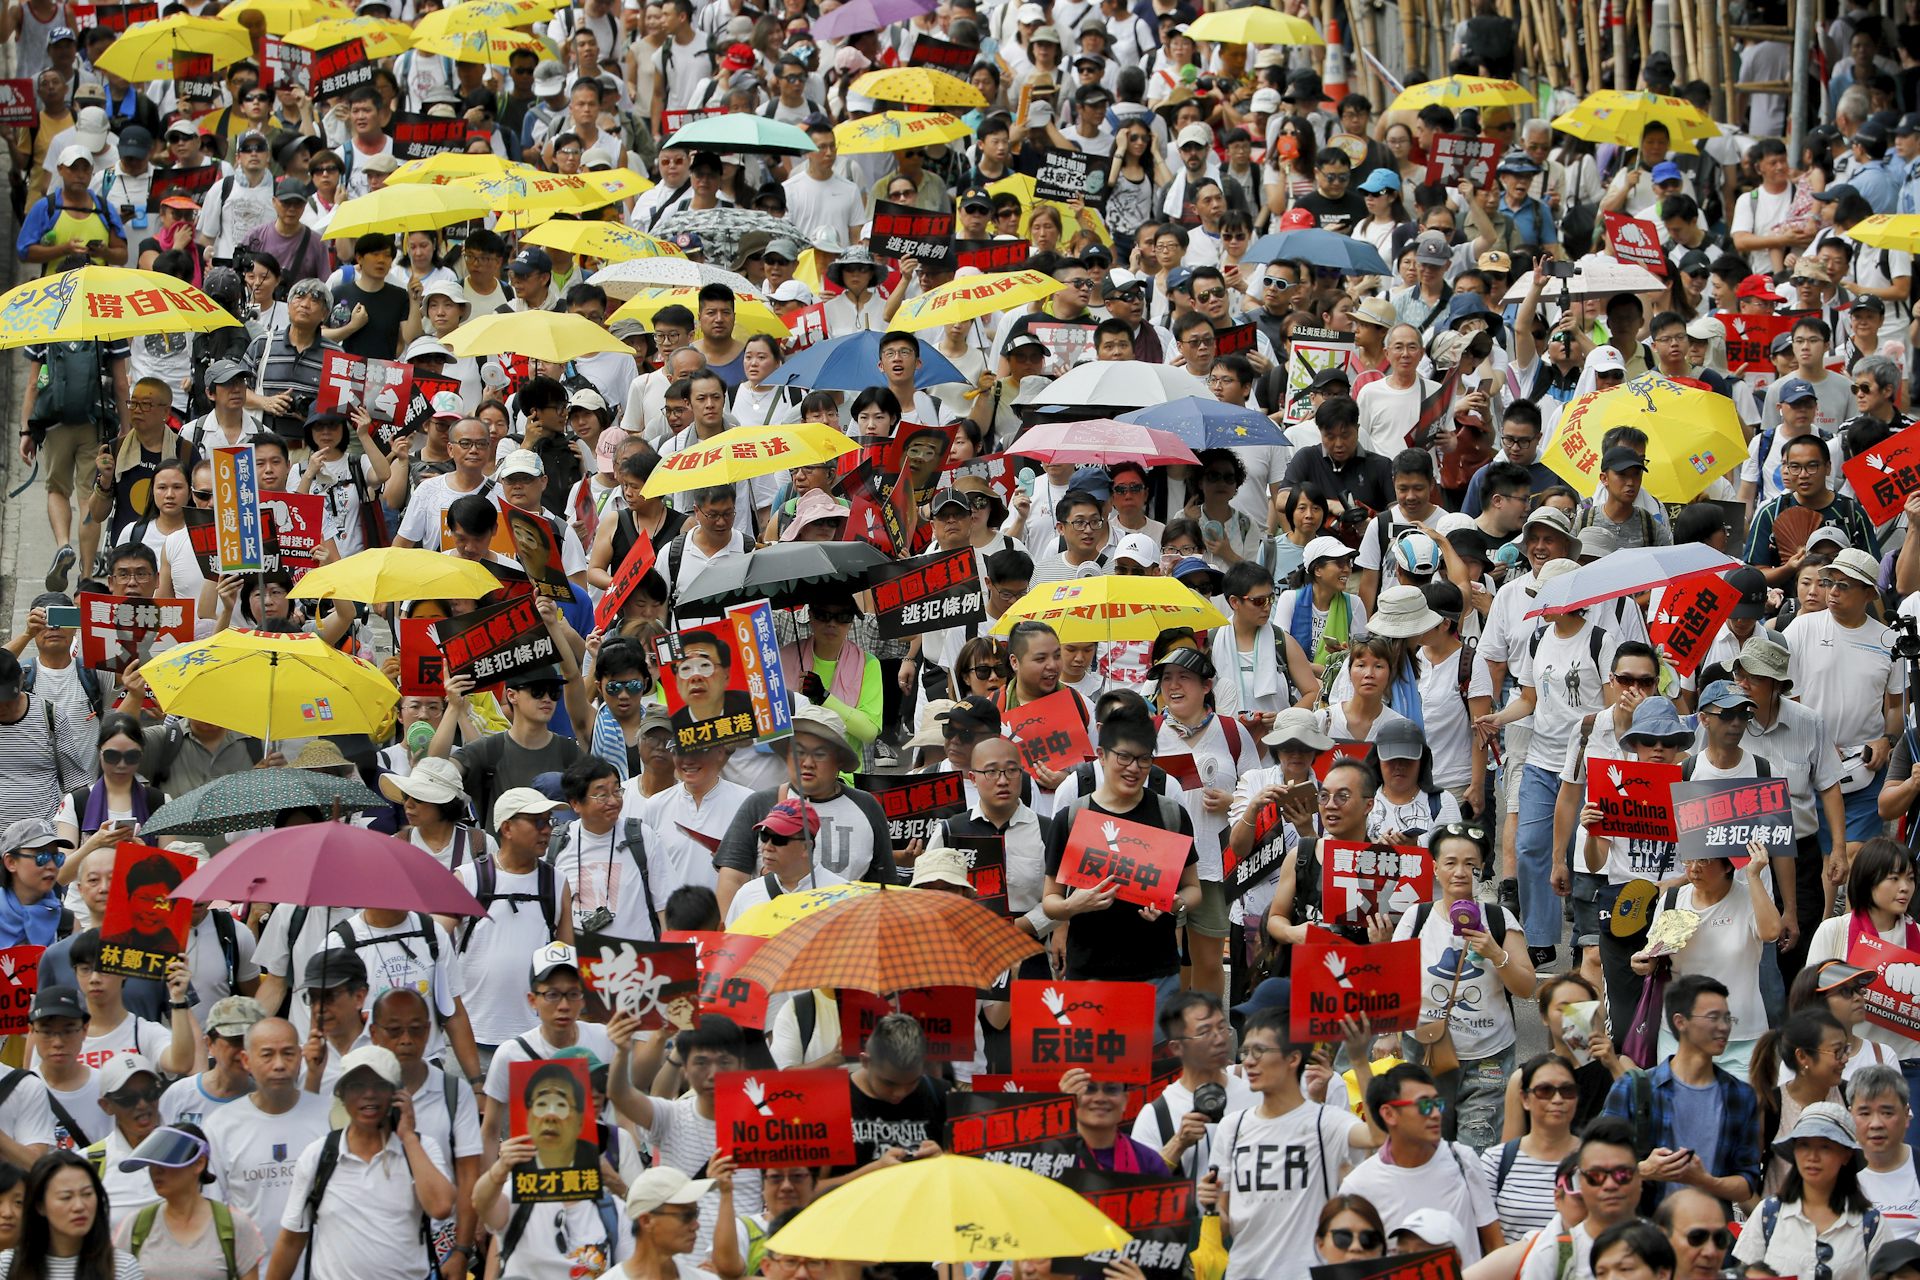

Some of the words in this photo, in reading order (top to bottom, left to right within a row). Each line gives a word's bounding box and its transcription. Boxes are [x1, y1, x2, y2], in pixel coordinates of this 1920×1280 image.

[322, 66, 372, 93] 逃犯條例
[1435, 155, 1490, 187] 下台
[886, 236, 948, 259] 逃犯條例
[331, 356, 404, 386] 賣港林鄭
[329, 376, 400, 421] 下台
[1872, 460, 1920, 508] 反送
[218, 459, 239, 562] 69遊行
[236, 455, 257, 560] 感動市民
[277, 534, 314, 549] 對送中
[279, 548, 290, 557] TO
[876, 550, 973, 611] 撤回修訂
[90, 601, 183, 628] 賣港林鄭
[901, 591, 980, 627] 逃犯條例
[1667, 587, 1719, 658] 反送中
[444, 598, 536, 671] 撤回修訂
[474, 636, 553, 680] 逃犯條例
[750, 612, 787, 726] 感動市民
[678, 713, 753, 747] 奴才賣港
[878, 774, 960, 817] 回修訂
[1600, 797, 1620, 817] No
[1621, 798, 1667, 820] China
[1678, 783, 1785, 830] 撤回修訂
[1601, 817, 1669, 837] Extradition
[1705, 824, 1793, 847] 逃犯條例
[1078, 846, 1162, 888] 反送中
[1236, 833, 1285, 886] 逃犯條例
[1333, 849, 1423, 877] 賣港林鄭
[1333, 875, 1421, 922] 下台
[590, 942, 671, 1019] 撤
[1310, 991, 1337, 1014] No
[1343, 991, 1399, 1014] China
[1031, 1027, 1126, 1065] 反送中
[732, 1121, 761, 1143] No
[765, 1116, 827, 1142] China
[952, 1097, 1074, 1154] 撤回修訂
[243, 1166, 280, 1182] LOUIS
[732, 1145, 830, 1166] Extradition
[1234, 1144, 1310, 1193] GER
[516, 1169, 599, 1194] 奴才賣港
[1091, 1186, 1190, 1231] 回修訂
